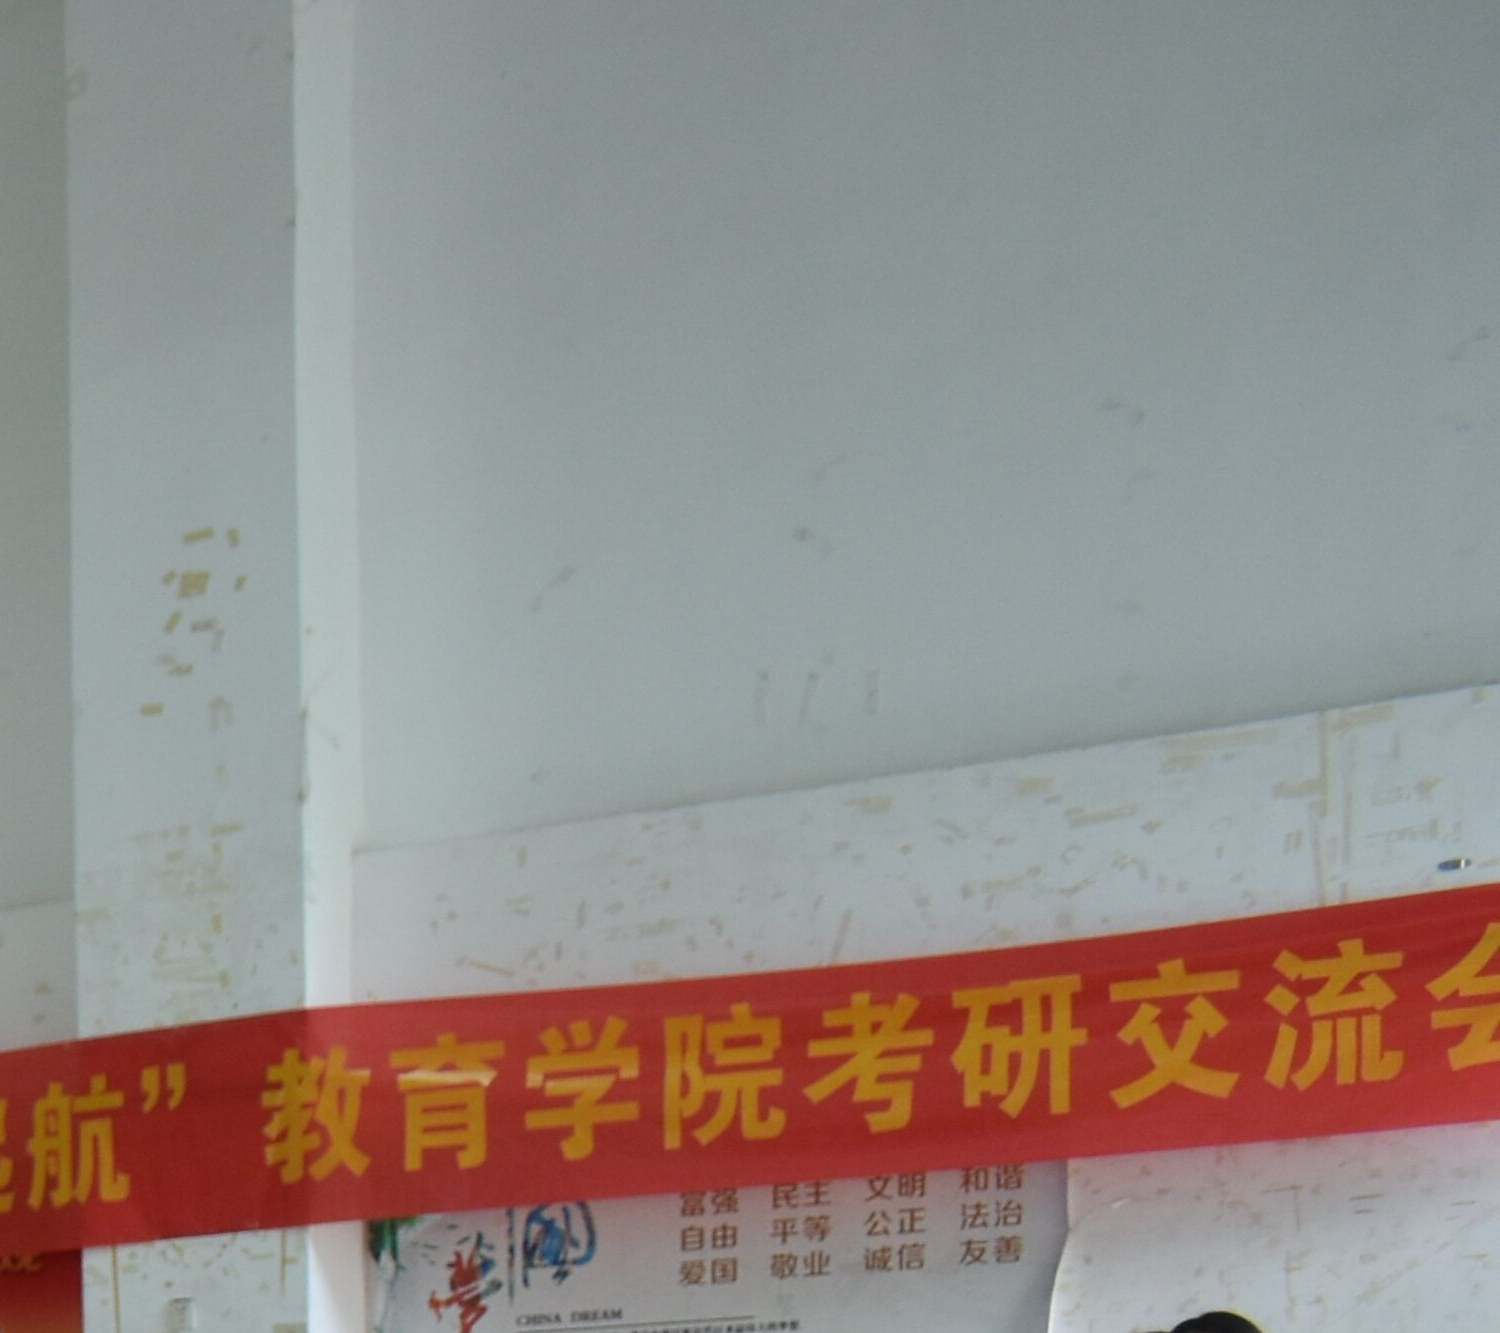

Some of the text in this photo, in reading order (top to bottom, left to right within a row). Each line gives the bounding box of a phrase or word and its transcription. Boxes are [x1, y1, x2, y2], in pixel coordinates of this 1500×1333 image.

[679, 1163, 1025, 1217] 富强 民主 文明 和谐
[680, 1199, 1023, 1252] 自由 平等 公正 法治
[678, 1234, 1025, 1287] 爱国 敬业 诚信 友善
[516, 1308, 623, 1327] CHINA DREAM
